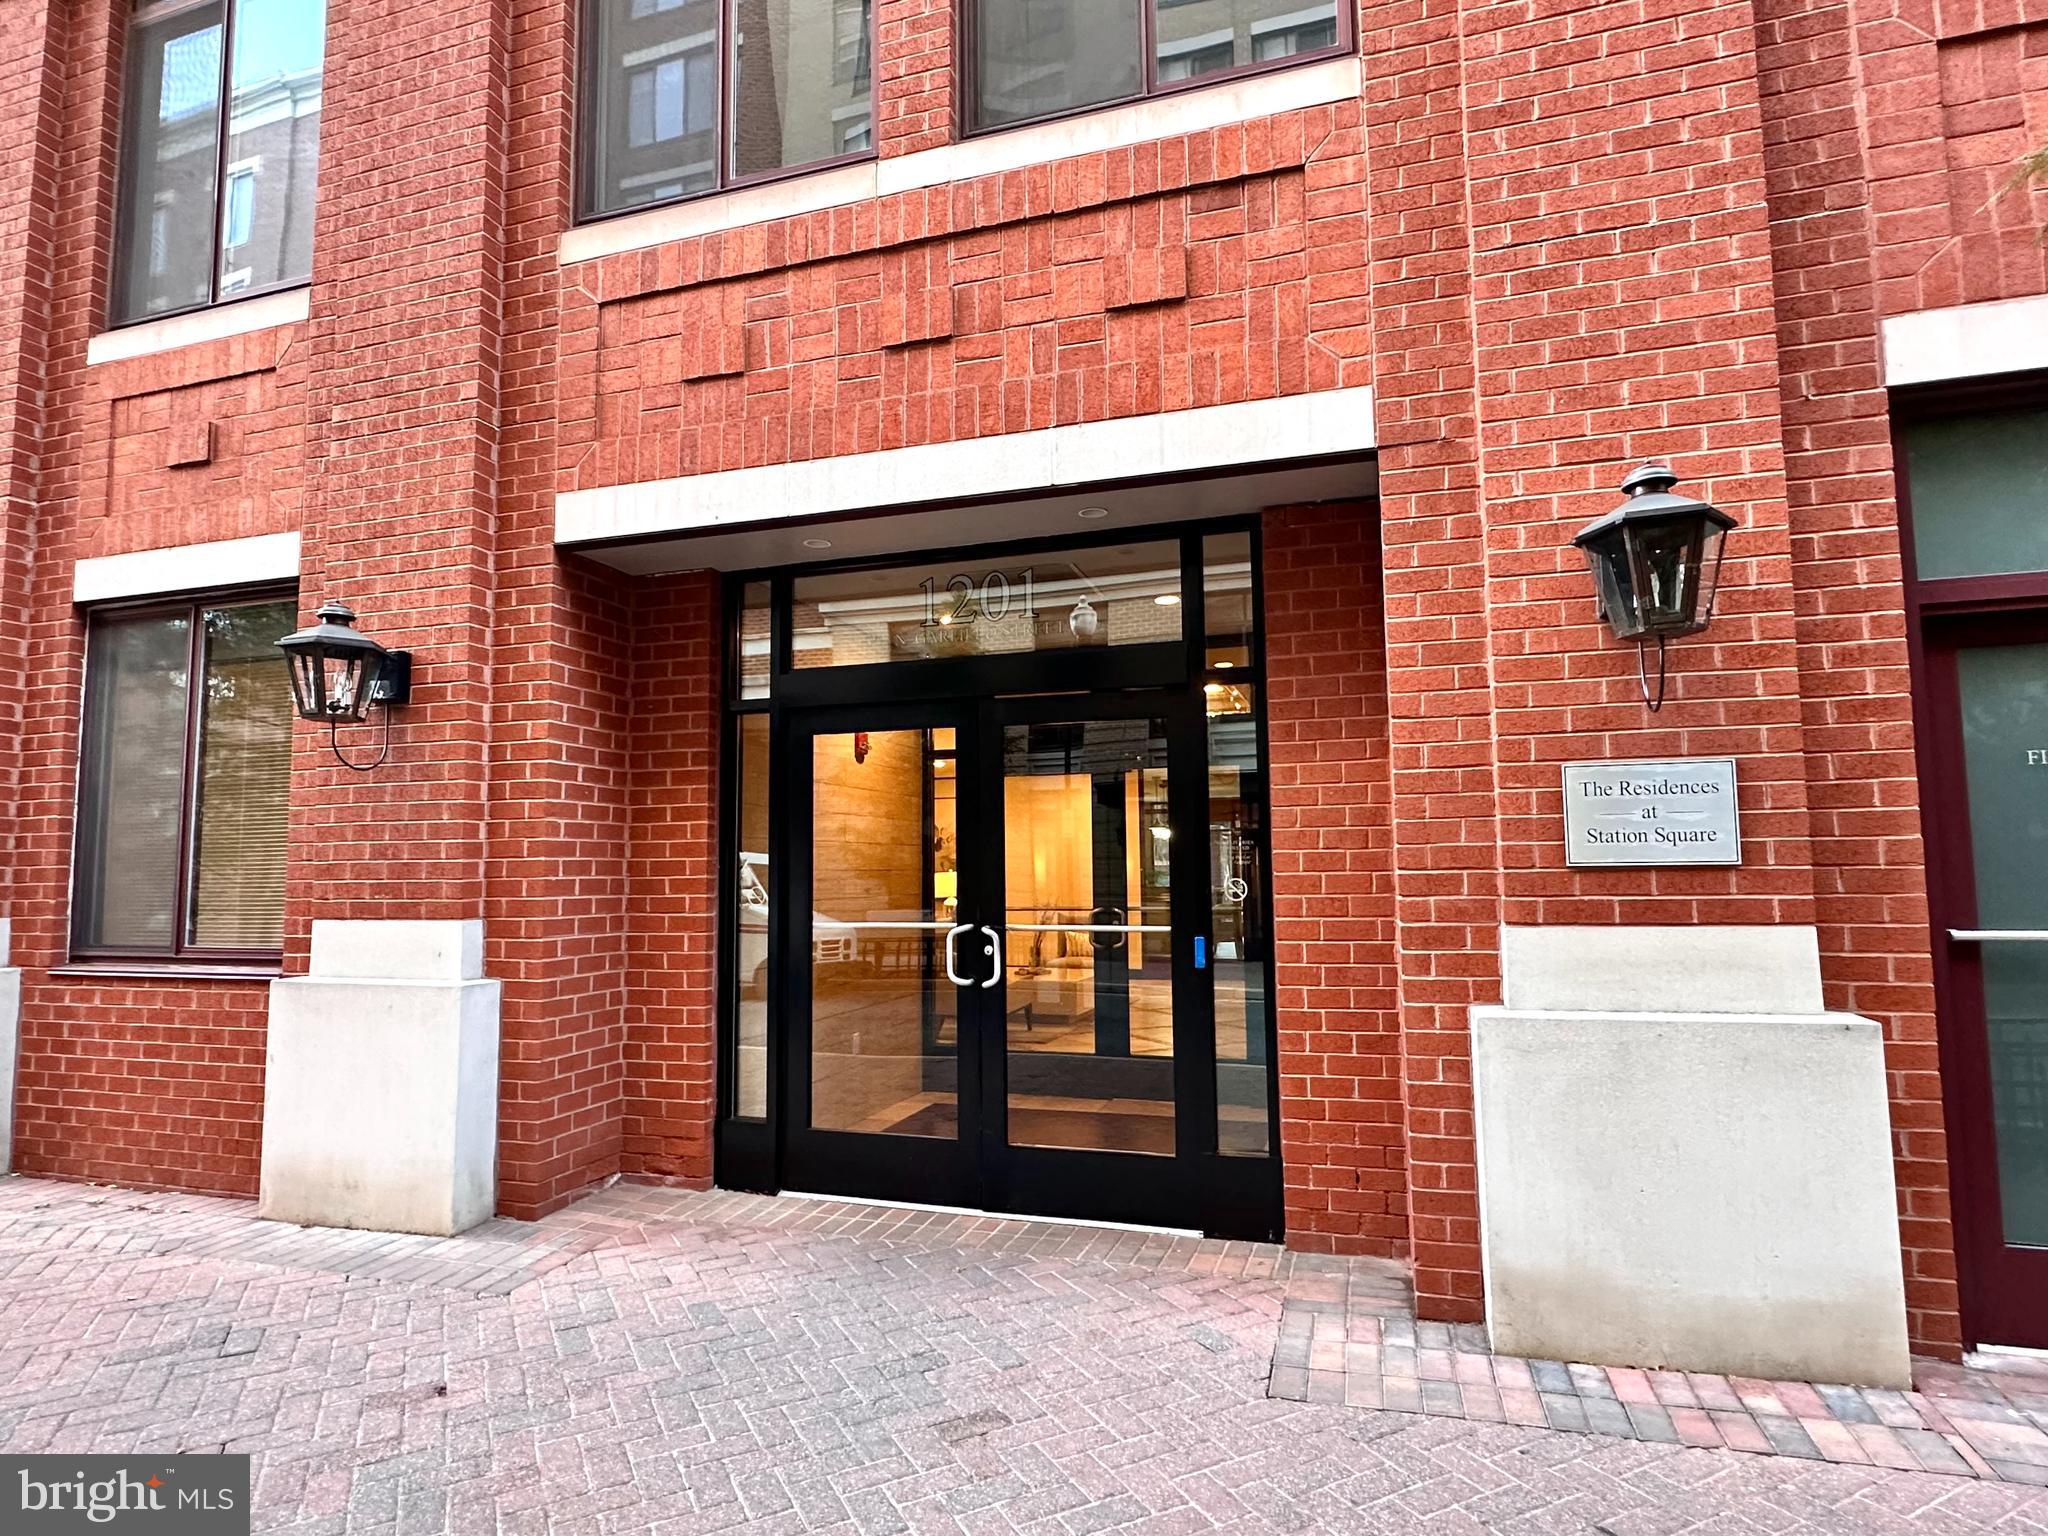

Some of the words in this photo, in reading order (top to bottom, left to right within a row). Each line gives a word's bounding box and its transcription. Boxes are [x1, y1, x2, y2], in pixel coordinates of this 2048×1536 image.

[919, 567, 1040, 628] 1201
[1579, 781, 1613, 797] The
[1619, 779, 1720, 796] Residences
[1641, 806, 1658, 819] at
[1587, 827, 1648, 844] Station
[1654, 827, 1717, 846] Square
